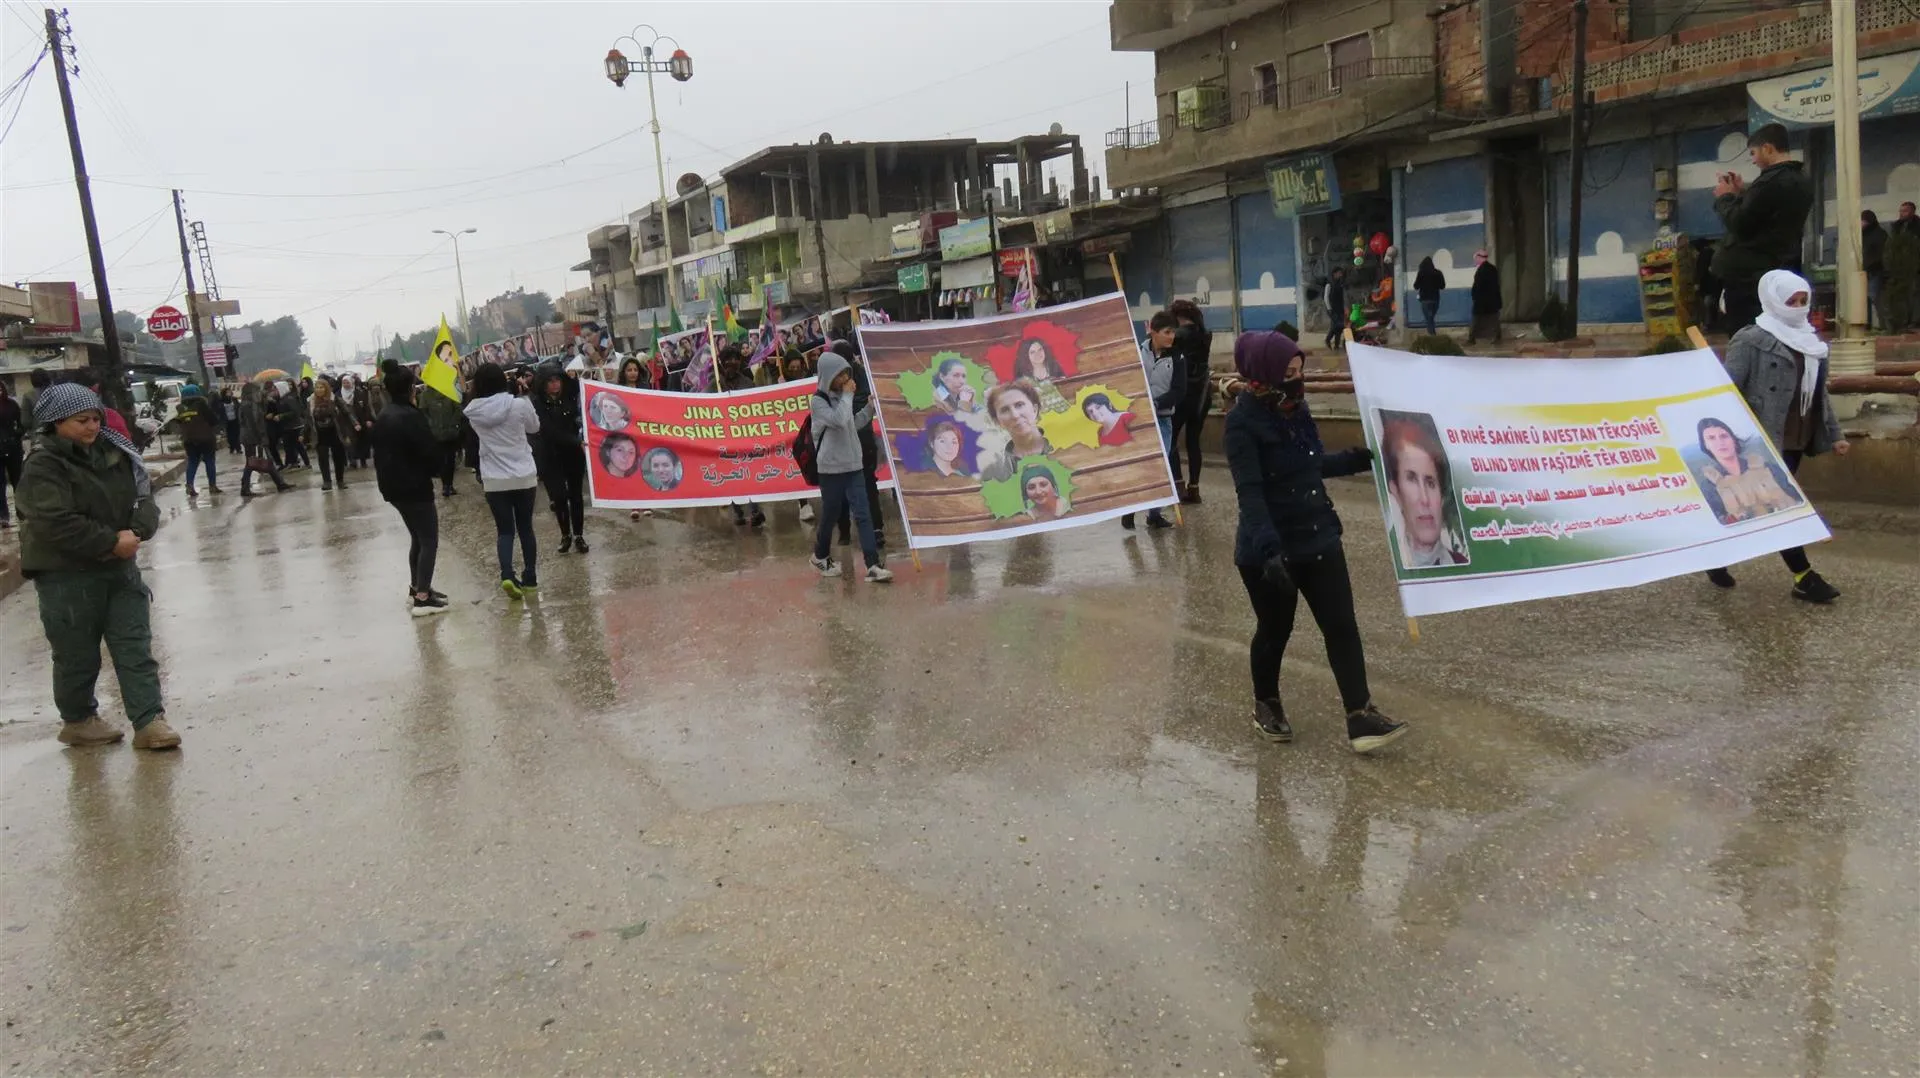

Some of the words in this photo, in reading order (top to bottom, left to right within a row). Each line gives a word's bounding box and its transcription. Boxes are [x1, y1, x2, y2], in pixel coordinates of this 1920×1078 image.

[149, 317, 189, 332] الملك
[684, 405, 724, 421] JINA
[637, 421, 726, 441] TEKOŞÎNÊ
[730, 423, 772, 439] DIKE
[775, 420, 800, 434] TA
[1446, 428, 1459, 444] BI
[1459, 425, 1488, 445] RIHÊ
[1489, 426, 1530, 445] SAKÎNE
[1530, 426, 1540, 444] Û
[1542, 428, 1597, 444] AVESTAN
[1597, 417, 1661, 440] TÊKOŞÎNÊ
[1470, 457, 1508, 473] BILIND
[1510, 456, 1541, 471] BIKIN
[1541, 450, 1594, 474] FAŞÎZMÊ
[1594, 448, 1618, 467] TÊK
[1620, 447, 1657, 465] BIBIN
[756, 464, 782, 482] حتى
